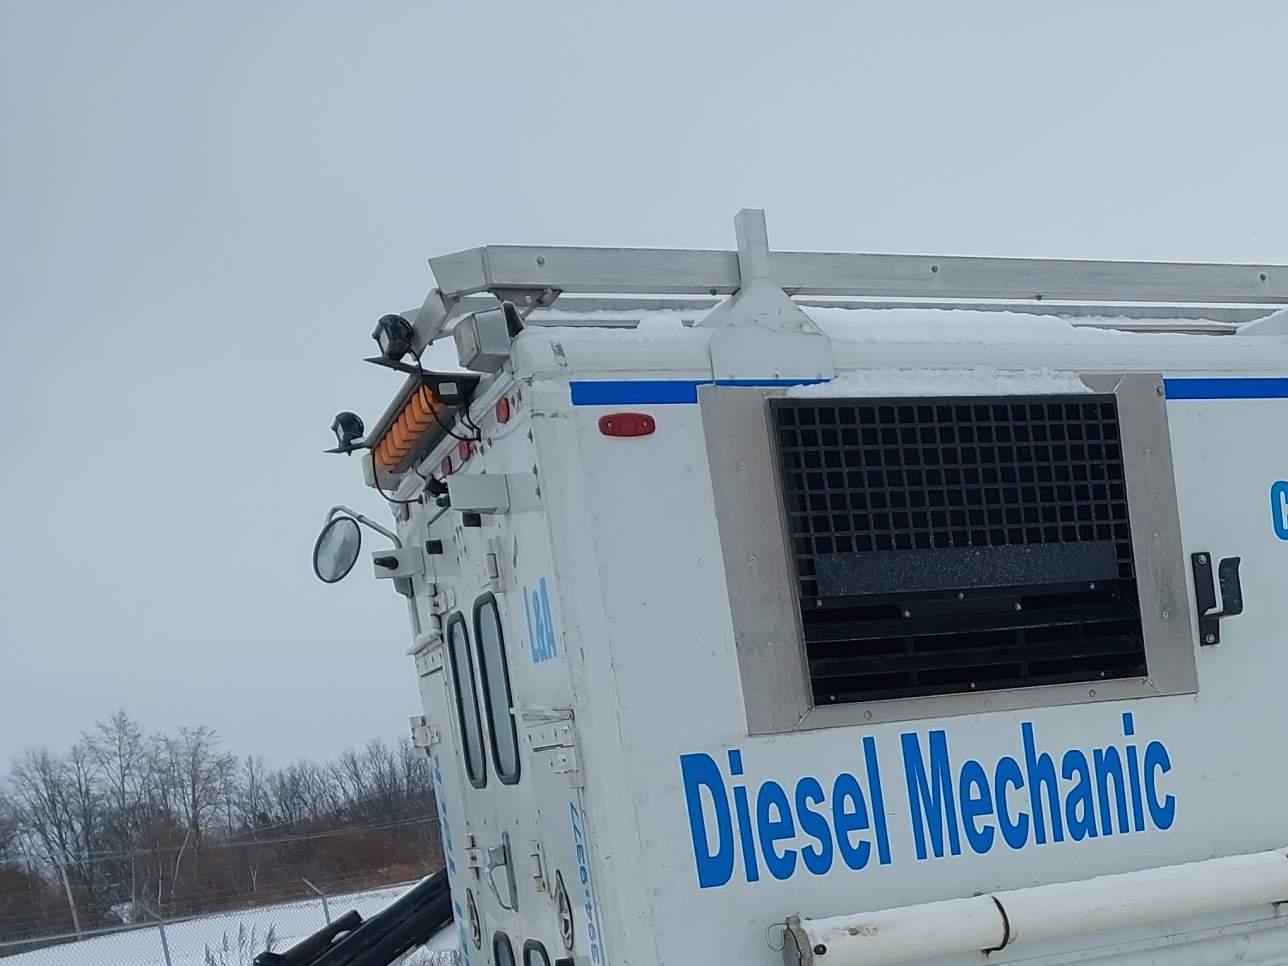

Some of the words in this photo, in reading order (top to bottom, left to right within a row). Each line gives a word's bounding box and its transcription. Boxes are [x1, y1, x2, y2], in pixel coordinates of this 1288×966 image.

[523, 577, 557, 663] L&A
[680, 737, 892, 889] Diesel
[900, 712, 1176, 861] Mechanic
